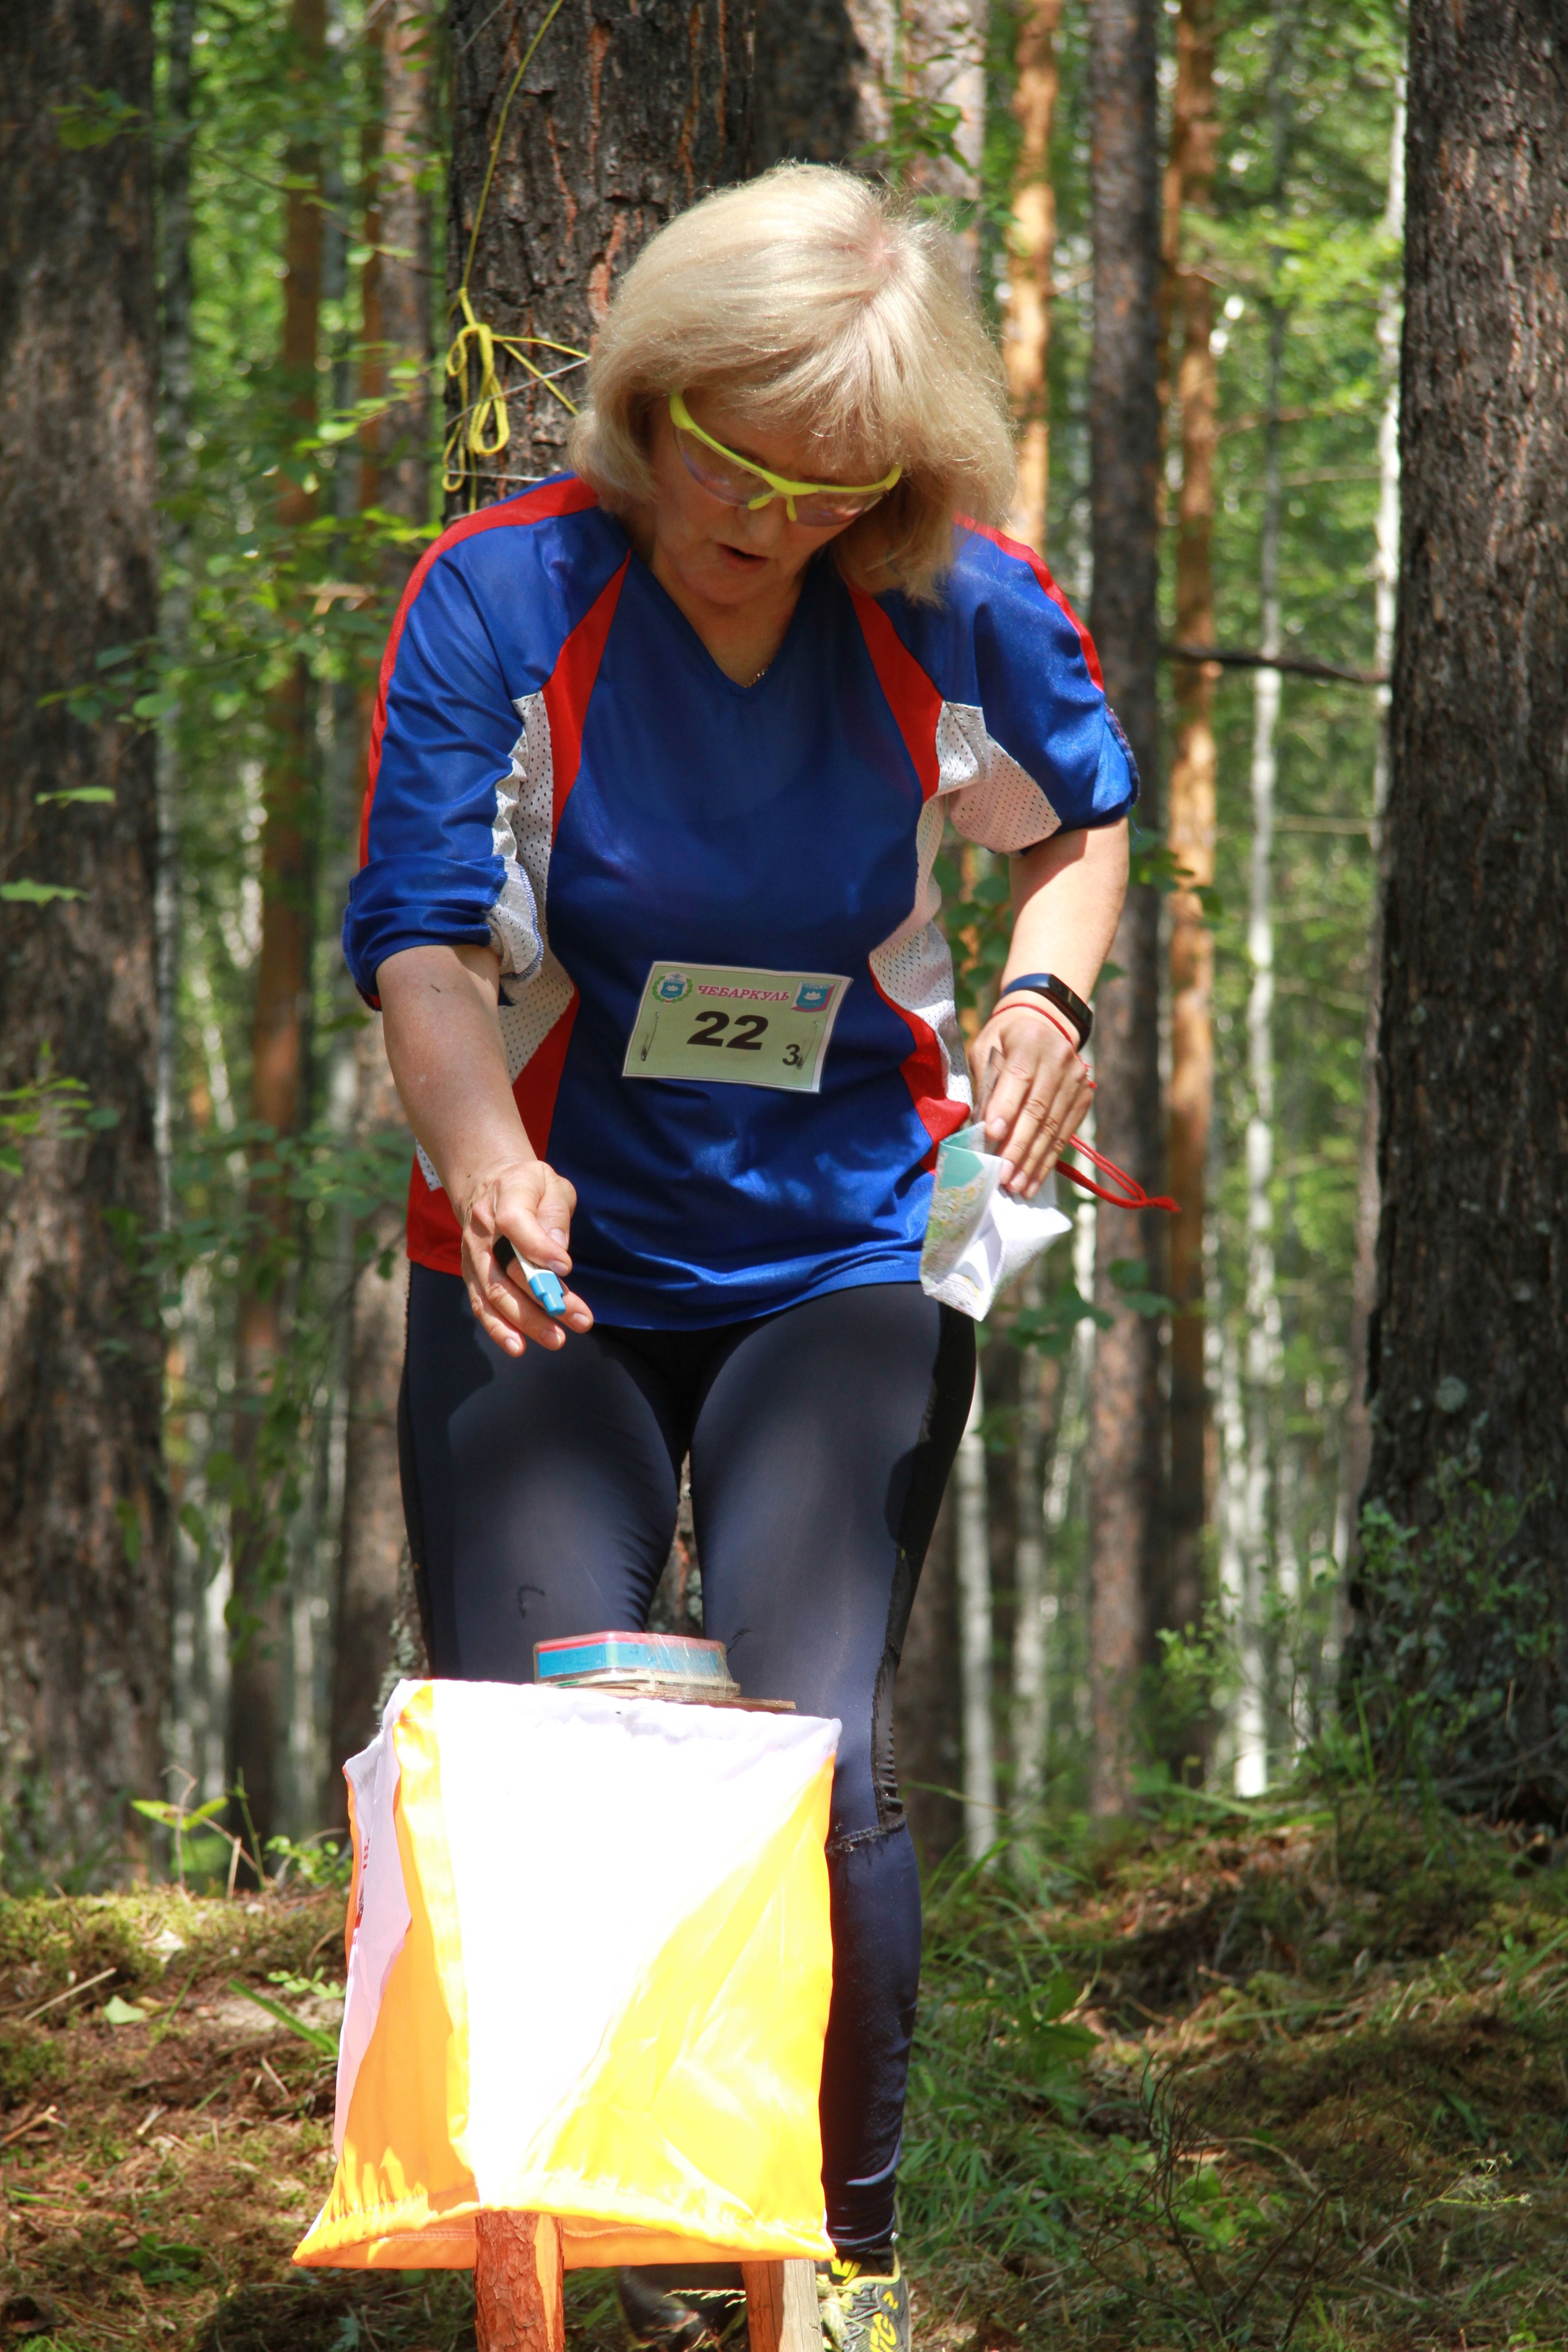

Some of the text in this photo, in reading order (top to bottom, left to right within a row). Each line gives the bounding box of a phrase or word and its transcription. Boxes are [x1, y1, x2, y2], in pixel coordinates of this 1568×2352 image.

[698, 984, 790, 1001] ЧЕБАРКУЛЬ
[686, 1011, 769, 1050] 22
[782, 1044, 801, 1066] 3
